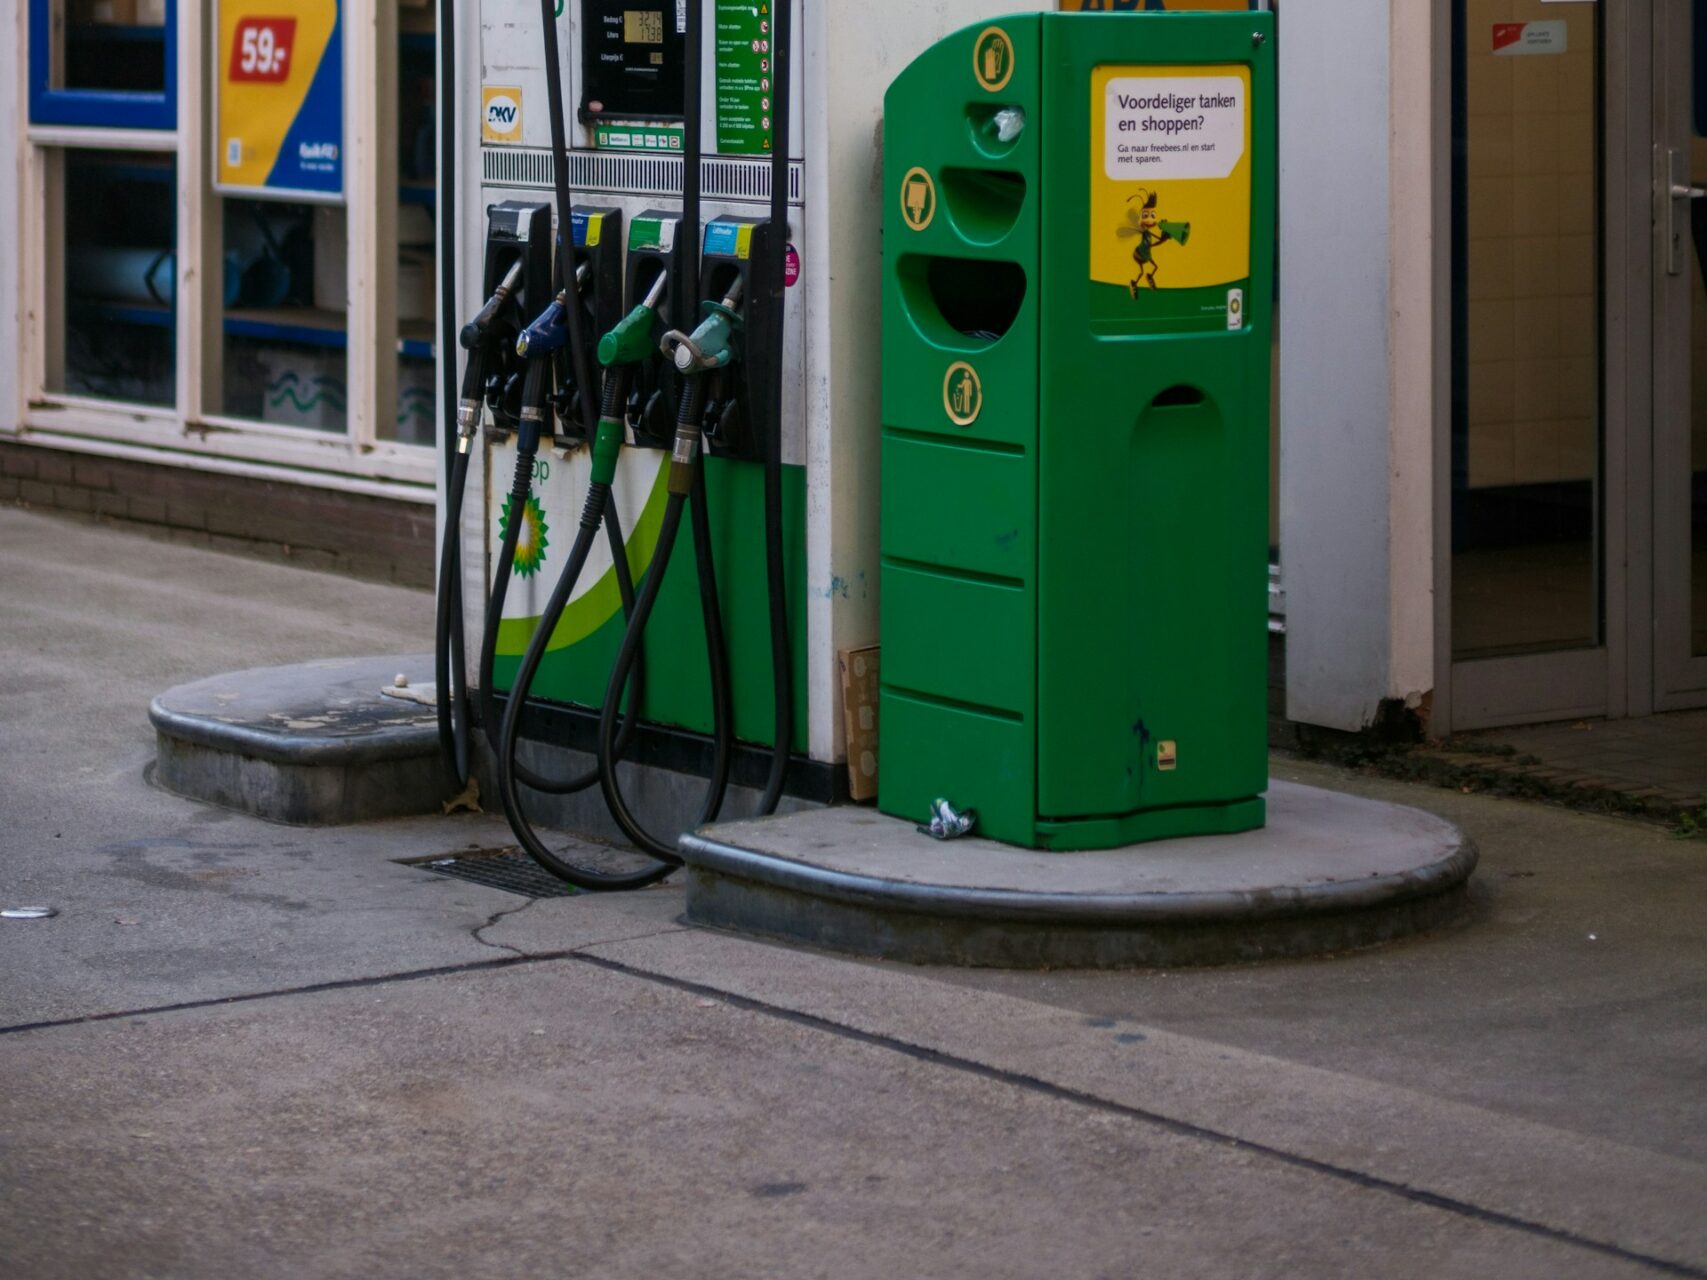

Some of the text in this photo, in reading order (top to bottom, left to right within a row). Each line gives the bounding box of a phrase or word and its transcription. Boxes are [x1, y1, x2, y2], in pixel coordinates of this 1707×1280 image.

[1118, 93, 1236, 113] Voordeliger tanken
[1118, 115, 1205, 136] en shoppen?
[1117, 144, 1129, 153] Ga
[1131, 145, 1148, 153] naar
[1150, 143, 1189, 153] freebees.nl
[1201, 143, 1216, 152] start
[1117, 155, 1163, 166] met sparen.
